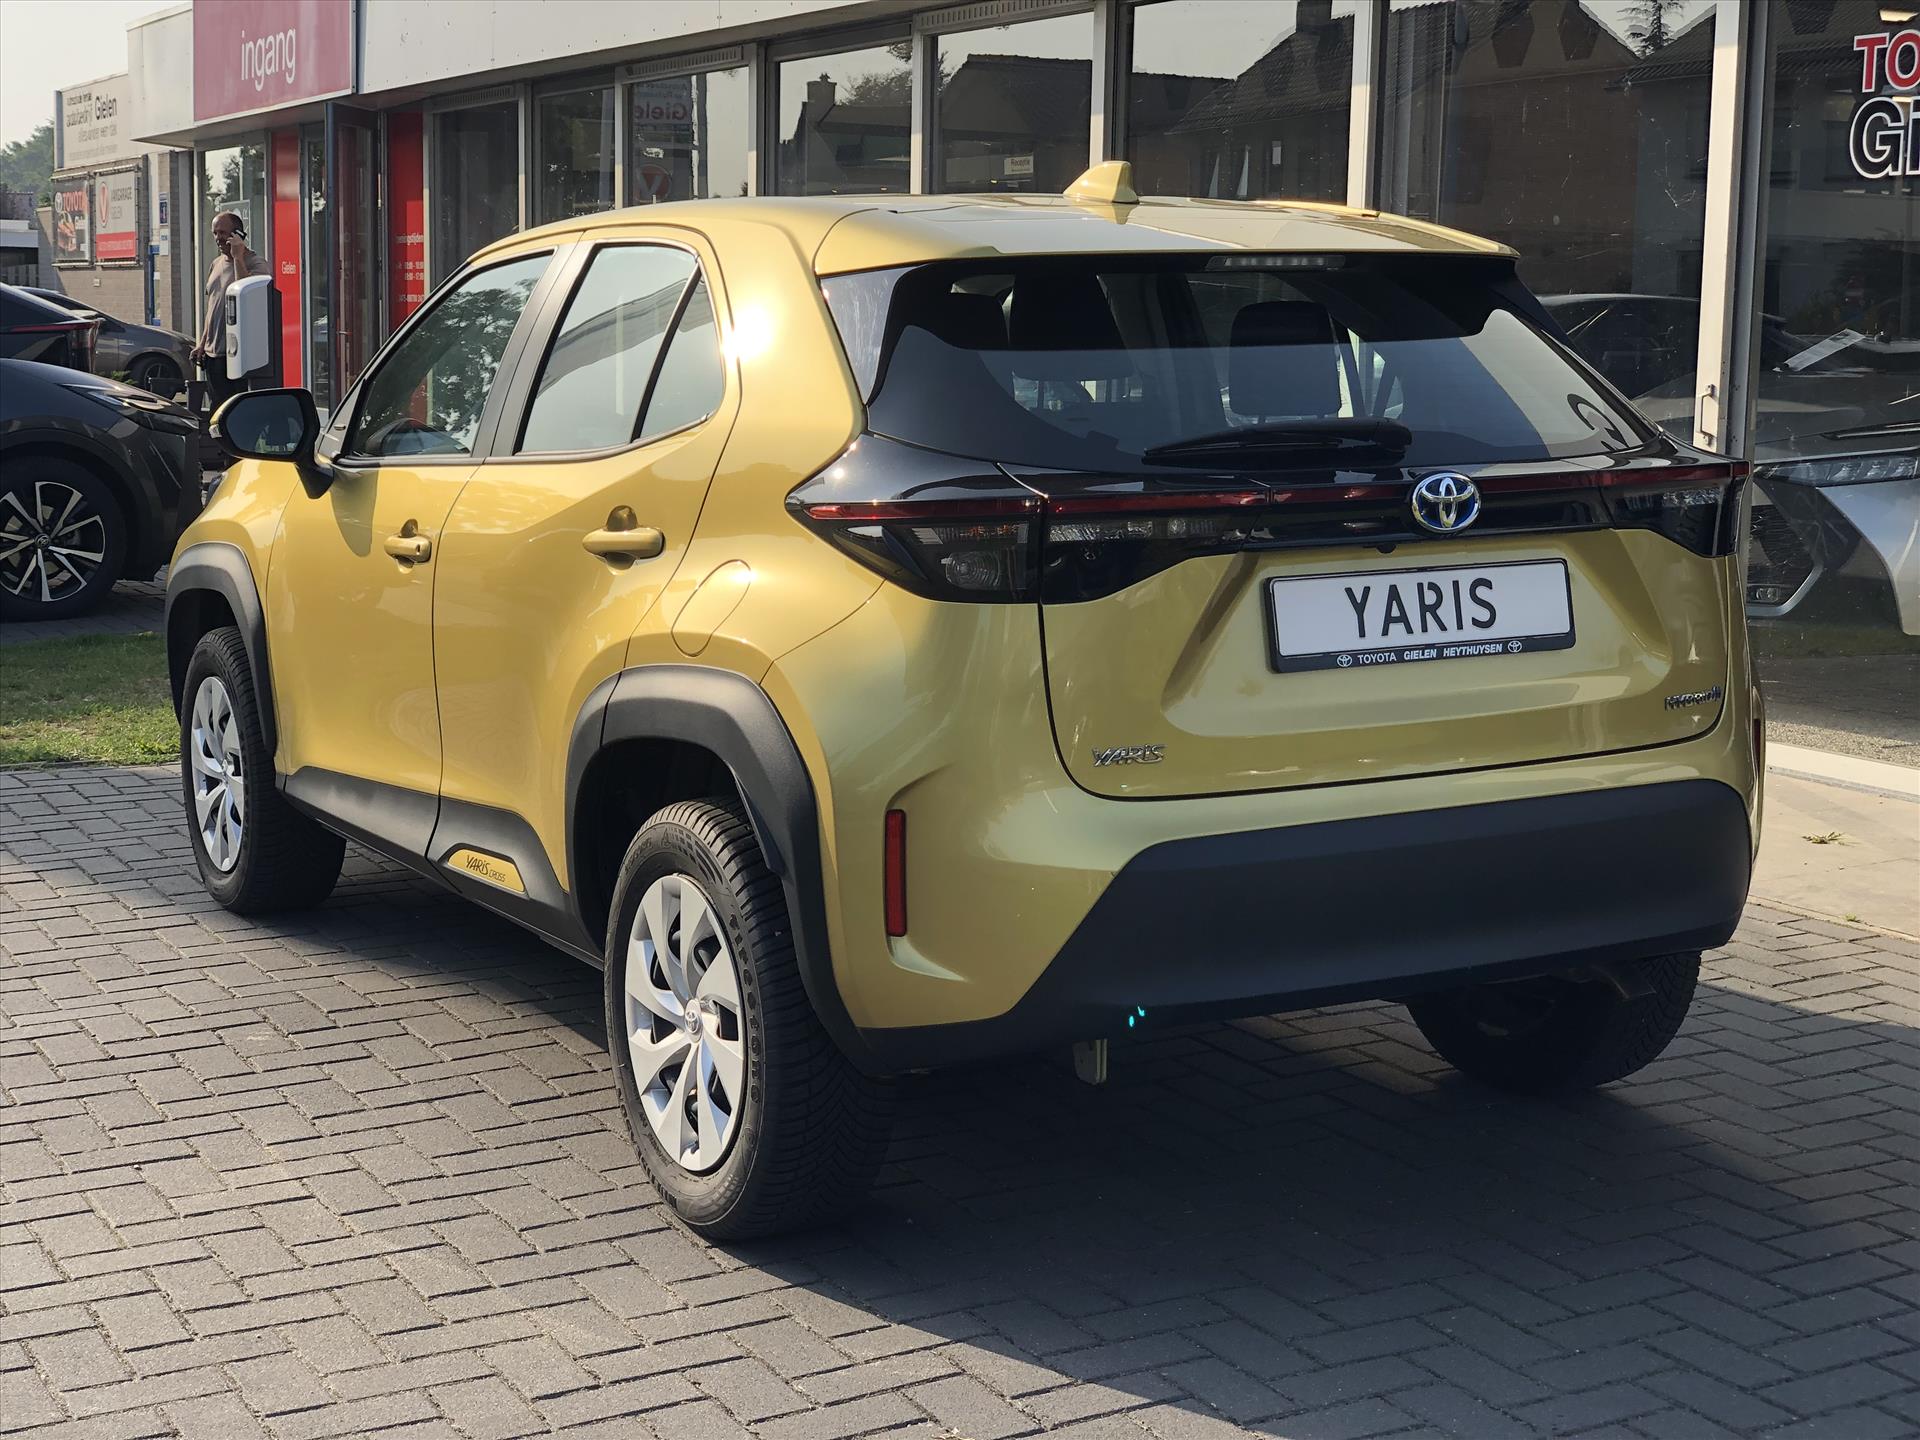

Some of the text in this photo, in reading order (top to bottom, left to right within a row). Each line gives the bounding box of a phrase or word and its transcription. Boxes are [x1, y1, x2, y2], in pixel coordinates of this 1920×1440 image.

[241, 28, 296, 92] ingang
[1853, 29, 1920, 93] TO
[95, 94, 117, 120] Gielen
[281, 261, 296, 274] Gielen
[1344, 577, 1497, 638] YARIS
[1357, 643, 1503, 665] TOYOTA GIELEN HEYTHUYSEN
[466, 855, 489, 875] YARIS
